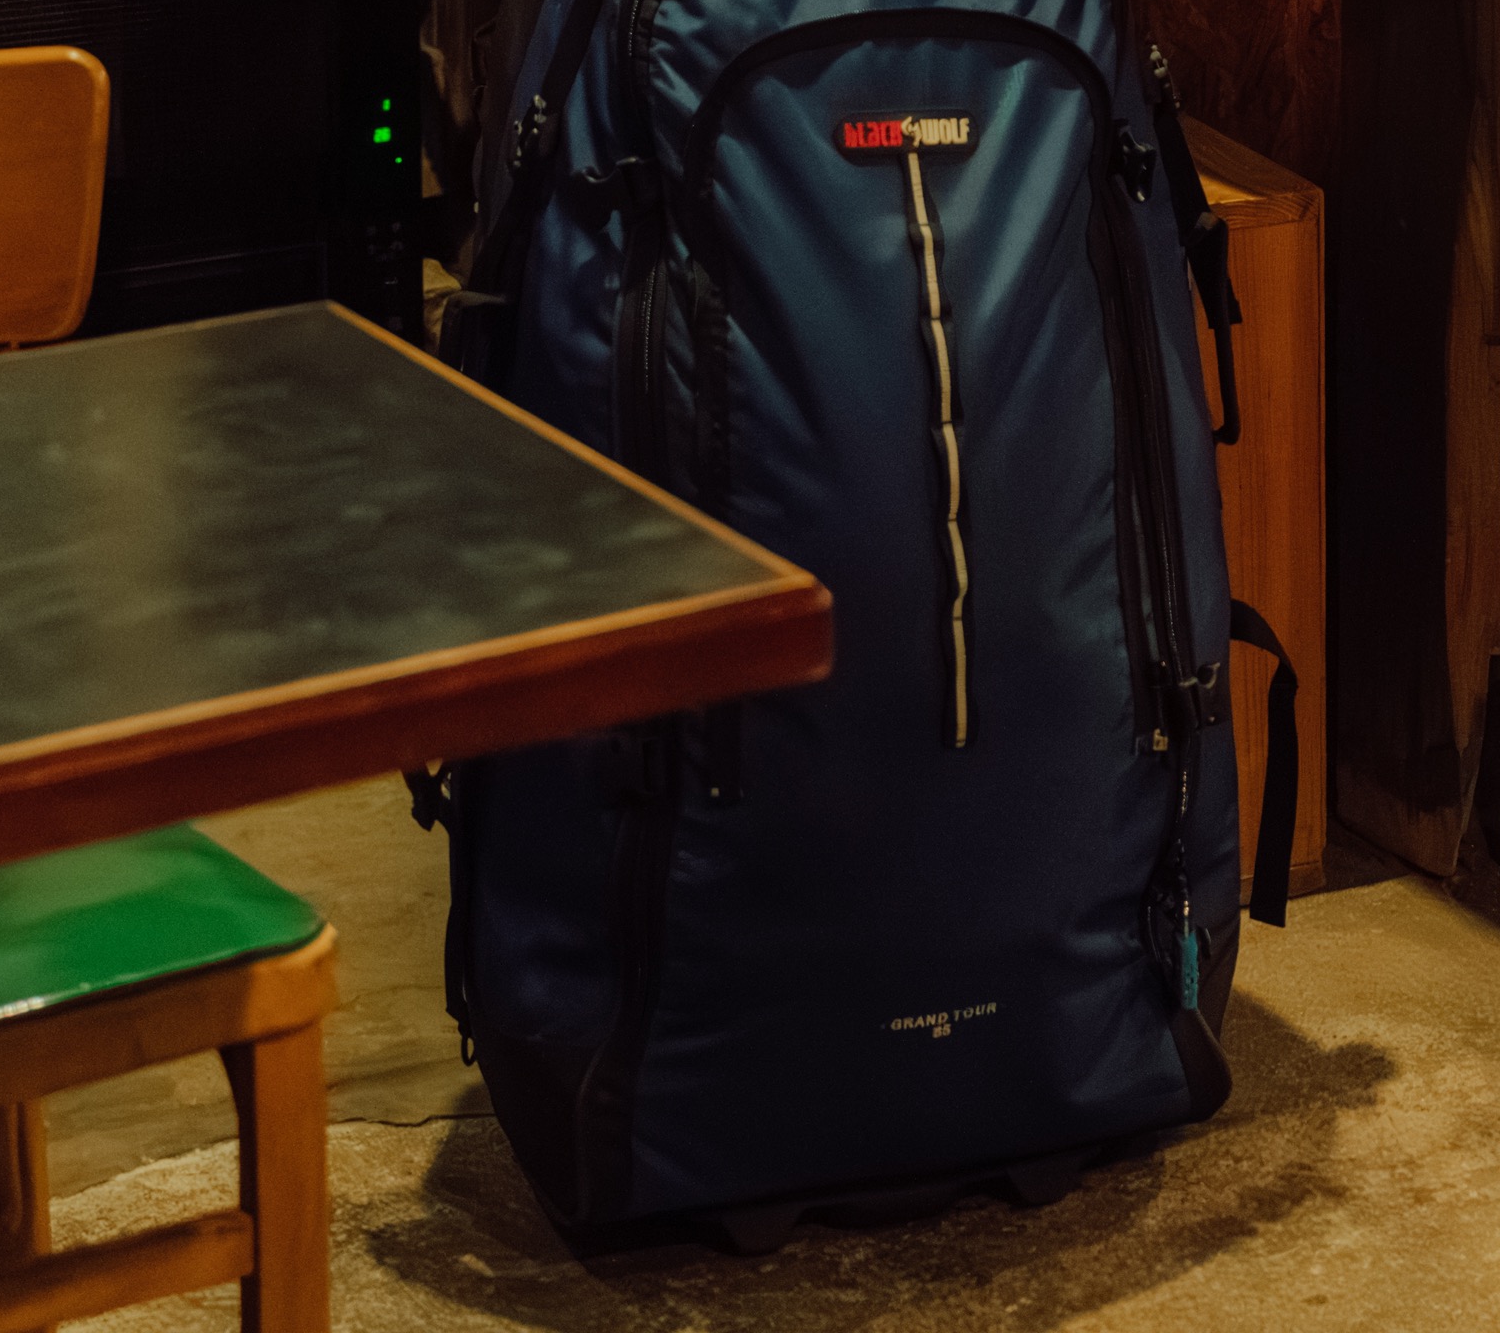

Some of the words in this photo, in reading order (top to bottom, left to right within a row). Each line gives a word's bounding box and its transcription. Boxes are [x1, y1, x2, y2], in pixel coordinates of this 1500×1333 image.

[920, 117, 970, 146] WOLF
[890, 1012, 949, 1031] GRAND
[953, 1002, 997, 1022] TOUR
